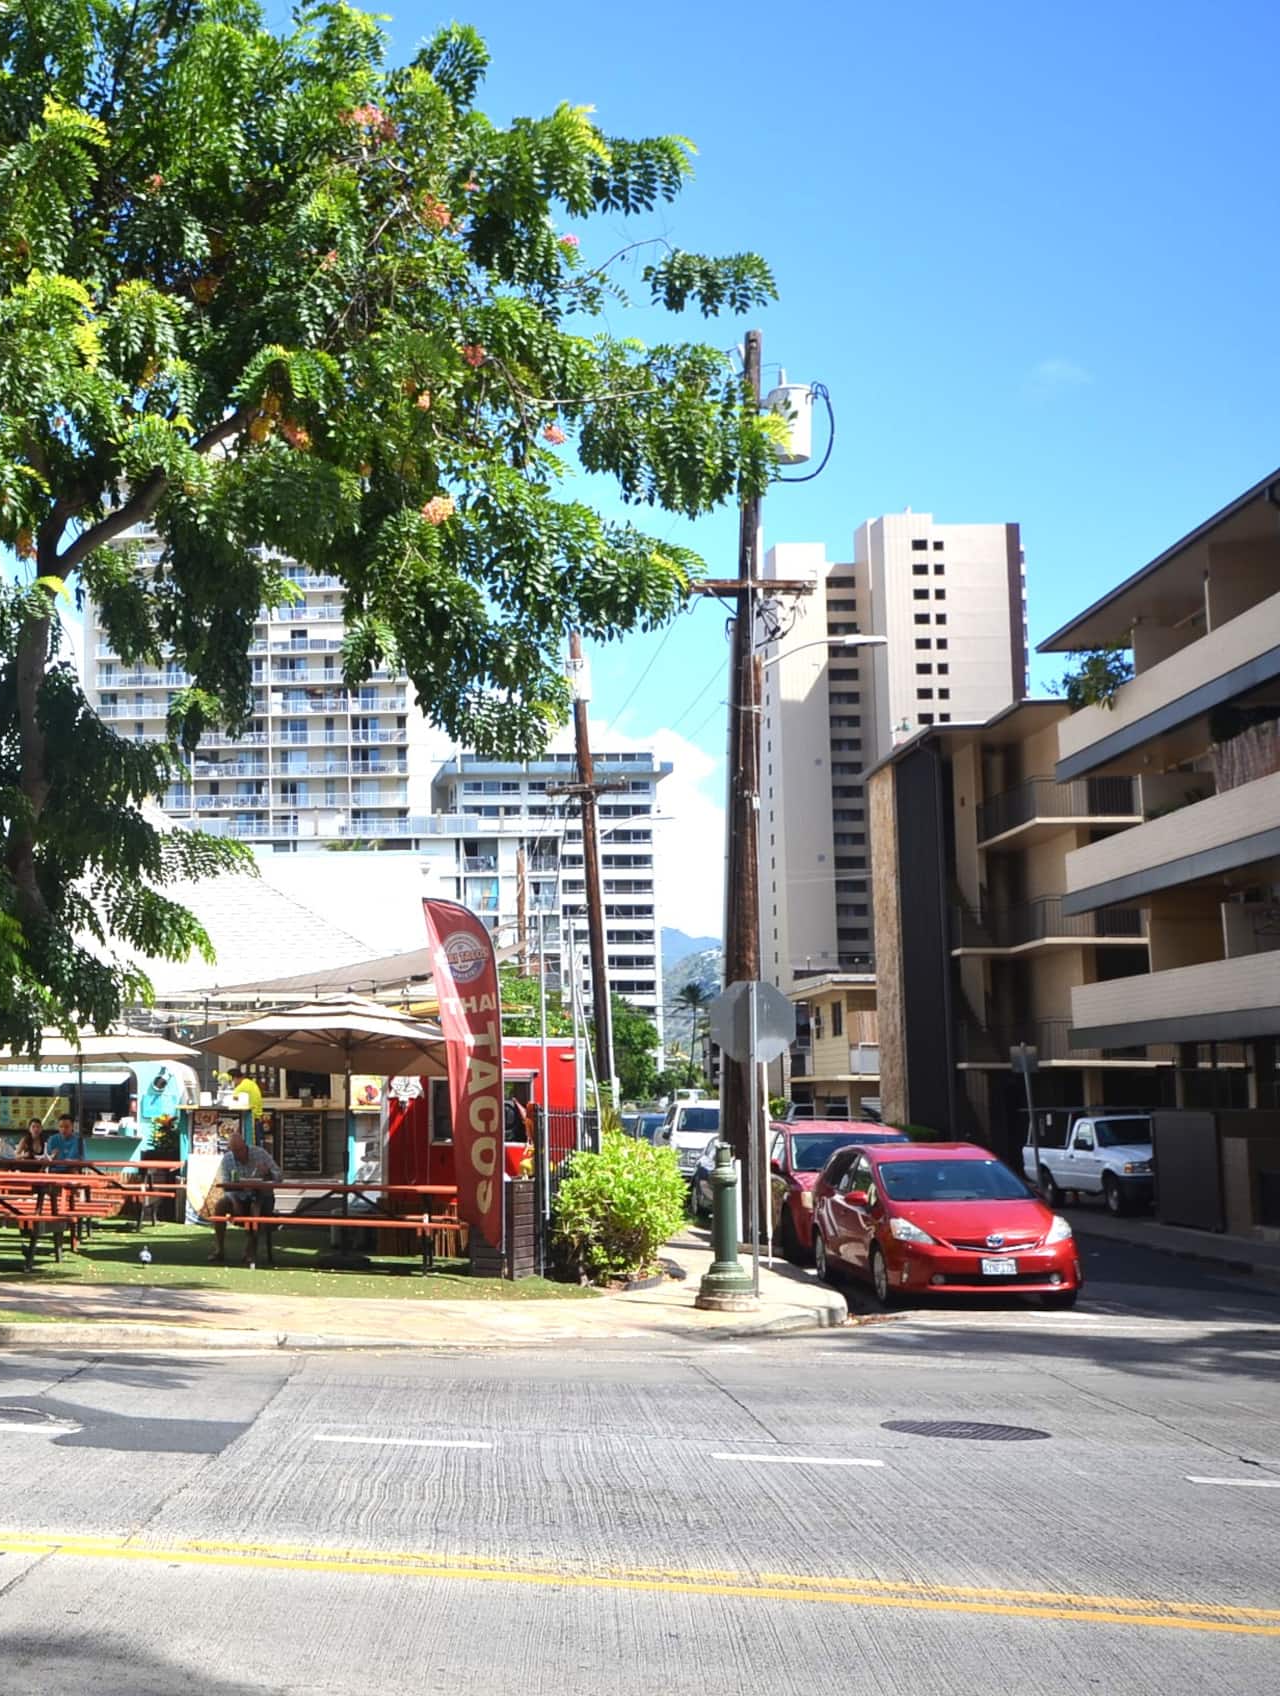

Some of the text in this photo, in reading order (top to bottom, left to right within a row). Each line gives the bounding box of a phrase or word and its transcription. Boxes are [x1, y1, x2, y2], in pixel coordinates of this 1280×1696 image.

[442, 992, 497, 1016] THAI
[41, 1063, 70, 1073] CATCH
[466, 1020, 500, 1215] TACOS
